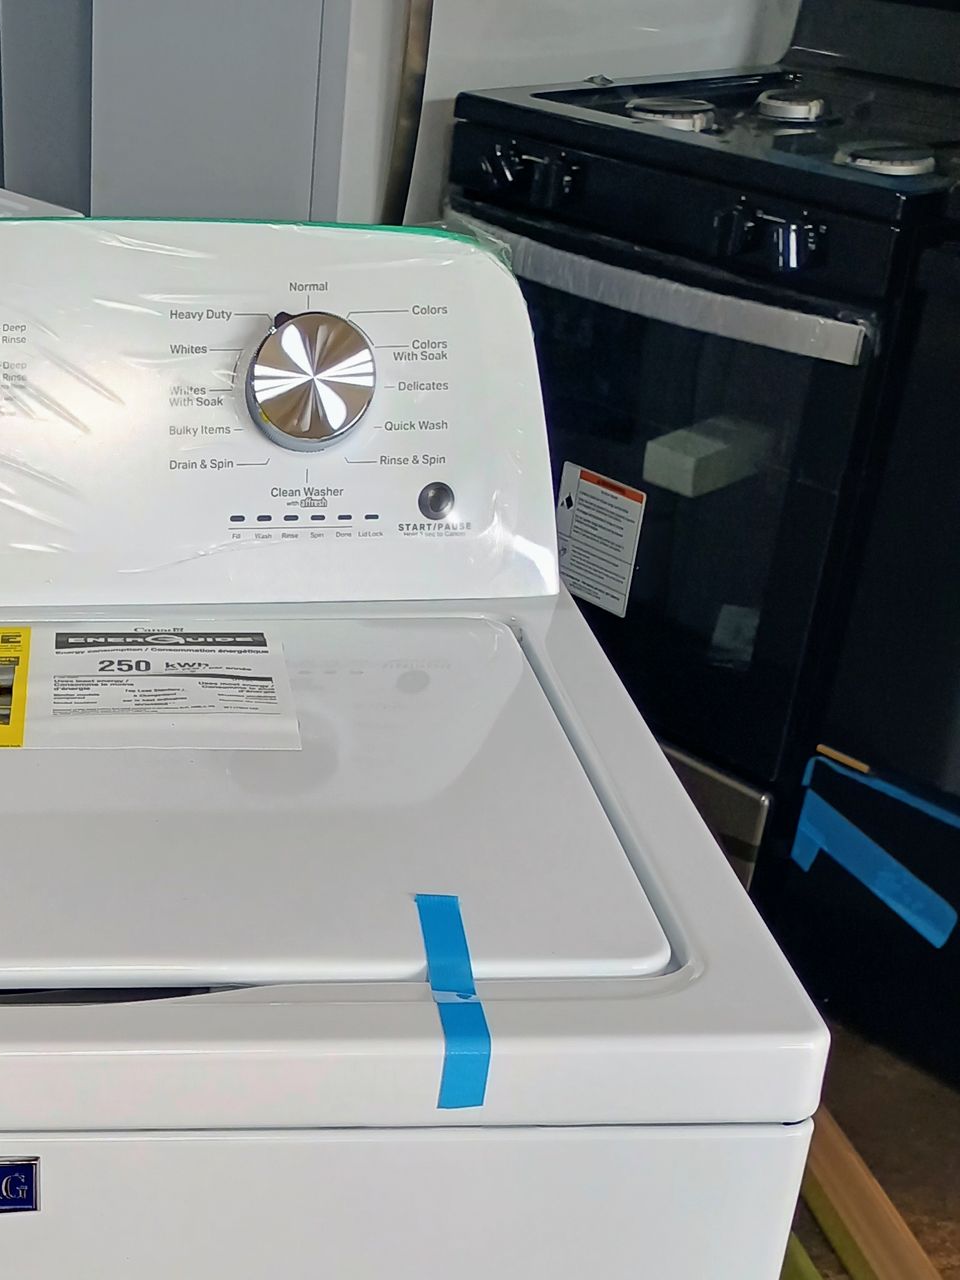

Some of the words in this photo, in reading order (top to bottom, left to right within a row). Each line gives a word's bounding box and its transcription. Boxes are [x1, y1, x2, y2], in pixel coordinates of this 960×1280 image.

[289, 281, 328, 292] Normal
[170, 310, 204, 321] Heavy
[206, 309, 232, 320] Duty
[411, 305, 448, 315] Colors
[2, 324, 27, 334] Deep
[2, 336, 27, 345] Rinse
[411, 339, 448, 350] Colors
[170, 344, 208, 354] Whites
[393, 351, 418, 361] With
[420, 350, 448, 361] Soak
[2, 362, 27, 371] Deep
[398, 381, 449, 391] Delicates
[169, 397, 193, 407] With
[196, 396, 224, 406] Soak
[169, 425, 197, 436] Bulky
[200, 425, 231, 434] Items
[384, 420, 416, 431] Quick
[418, 420, 448, 430] Wash
[169, 460, 197, 470] Drain
[199, 460, 208, 469] &
[210, 459, 234, 470] Spin
[380, 455, 409, 465] Rinse
[411, 455, 420, 465] &
[421, 454, 446, 466] Spin
[271, 487, 301, 497] Clean
[303, 487, 344, 497] Washer
[398, 522, 471, 532] START/PAUSE
[98, 659, 151, 672] 250
